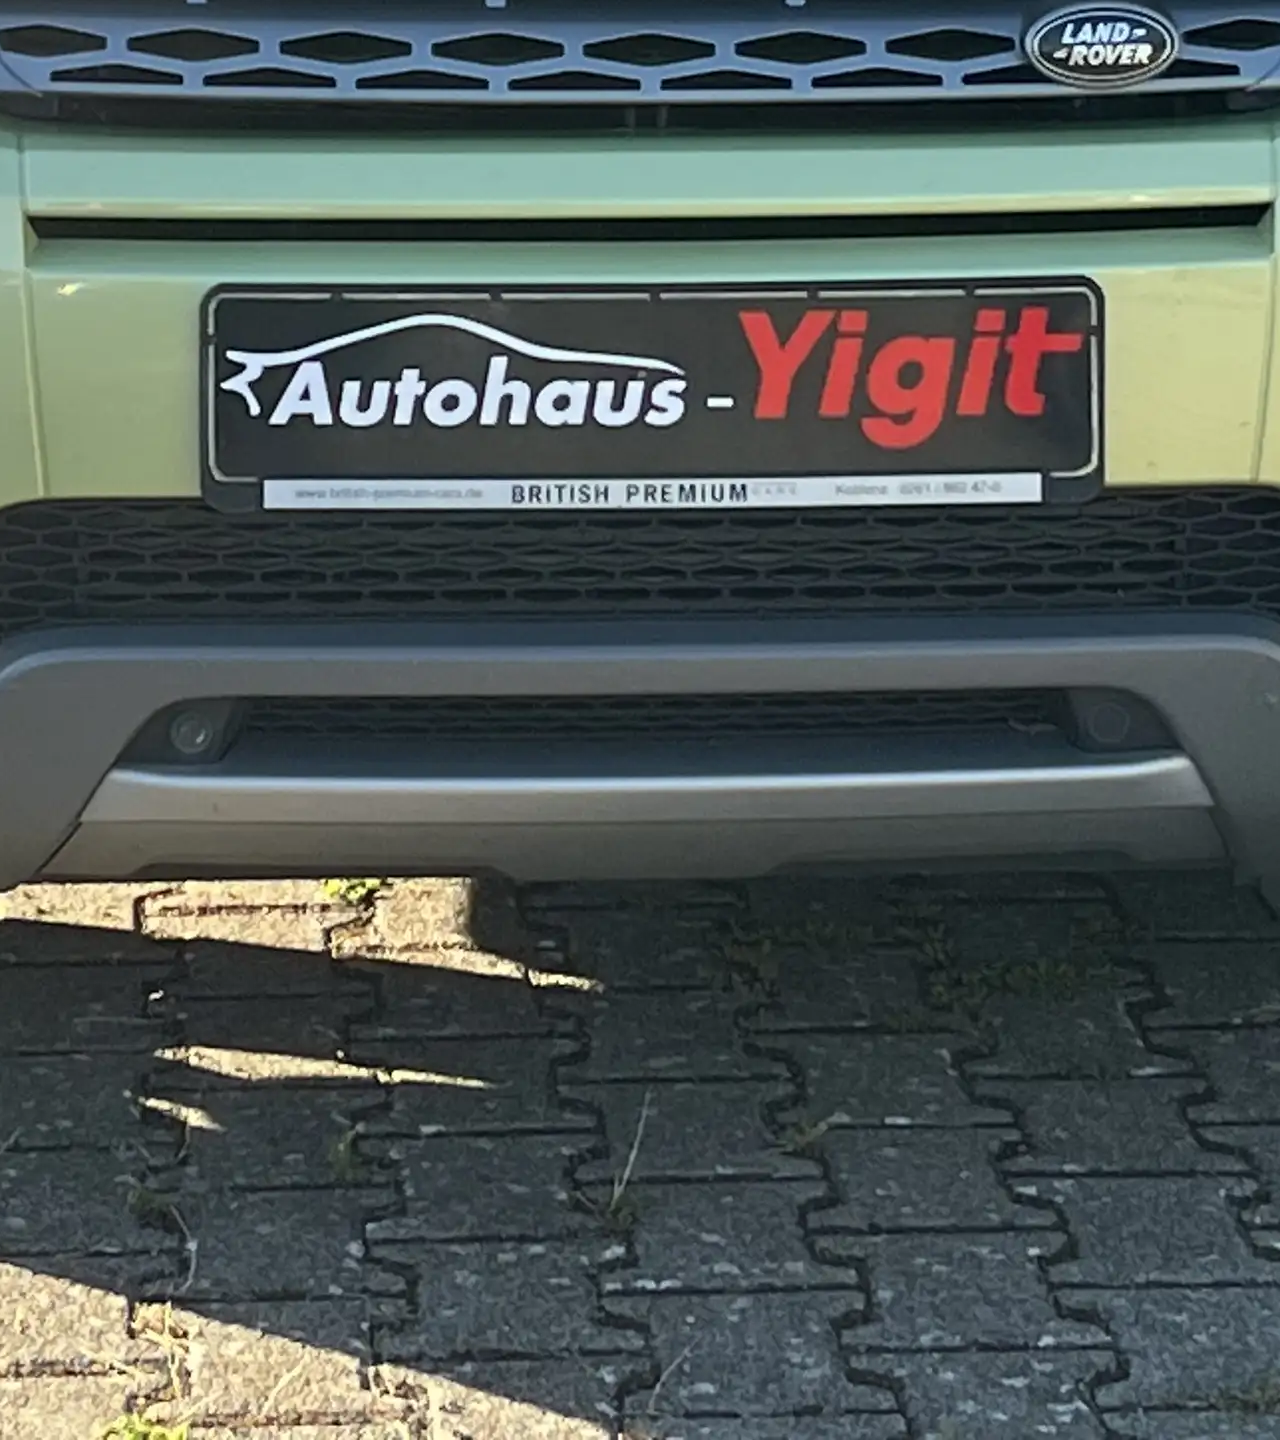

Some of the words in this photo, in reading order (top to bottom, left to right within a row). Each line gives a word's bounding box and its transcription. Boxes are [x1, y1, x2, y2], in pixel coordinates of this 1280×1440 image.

[268, 356, 687, 427] Autohaus
[738, 307, 1083, 449] Yigit
[510, 484, 609, 504] BRITISH
[625, 483, 749, 504] PREMIUM
